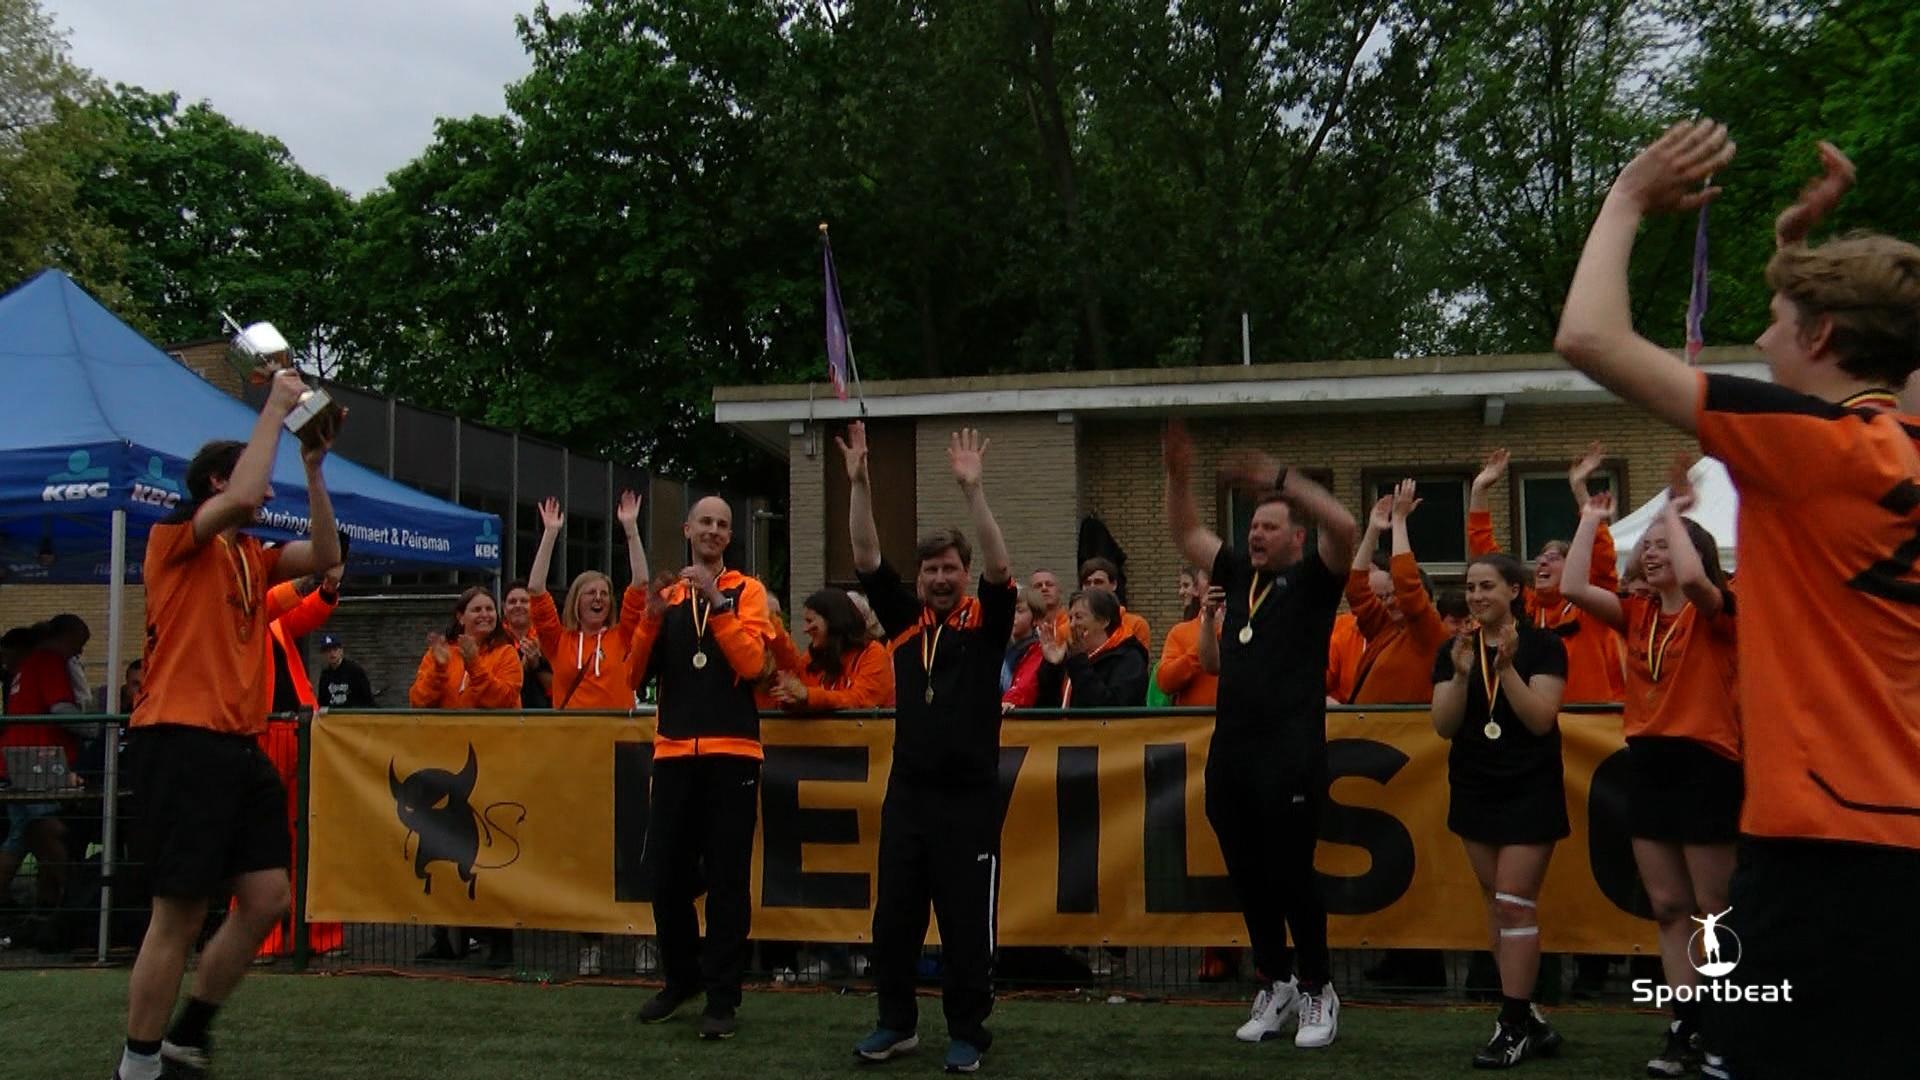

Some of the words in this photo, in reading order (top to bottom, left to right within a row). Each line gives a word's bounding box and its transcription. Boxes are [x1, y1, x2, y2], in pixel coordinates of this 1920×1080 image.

[42, 482, 110, 501] KBC
[131, 483, 181, 509] KBC
[390, 528, 400, 546] &
[401, 529, 450, 552] Peirsman
[475, 543, 499, 559] KBC
[613, 738, 1416, 915] EILS
